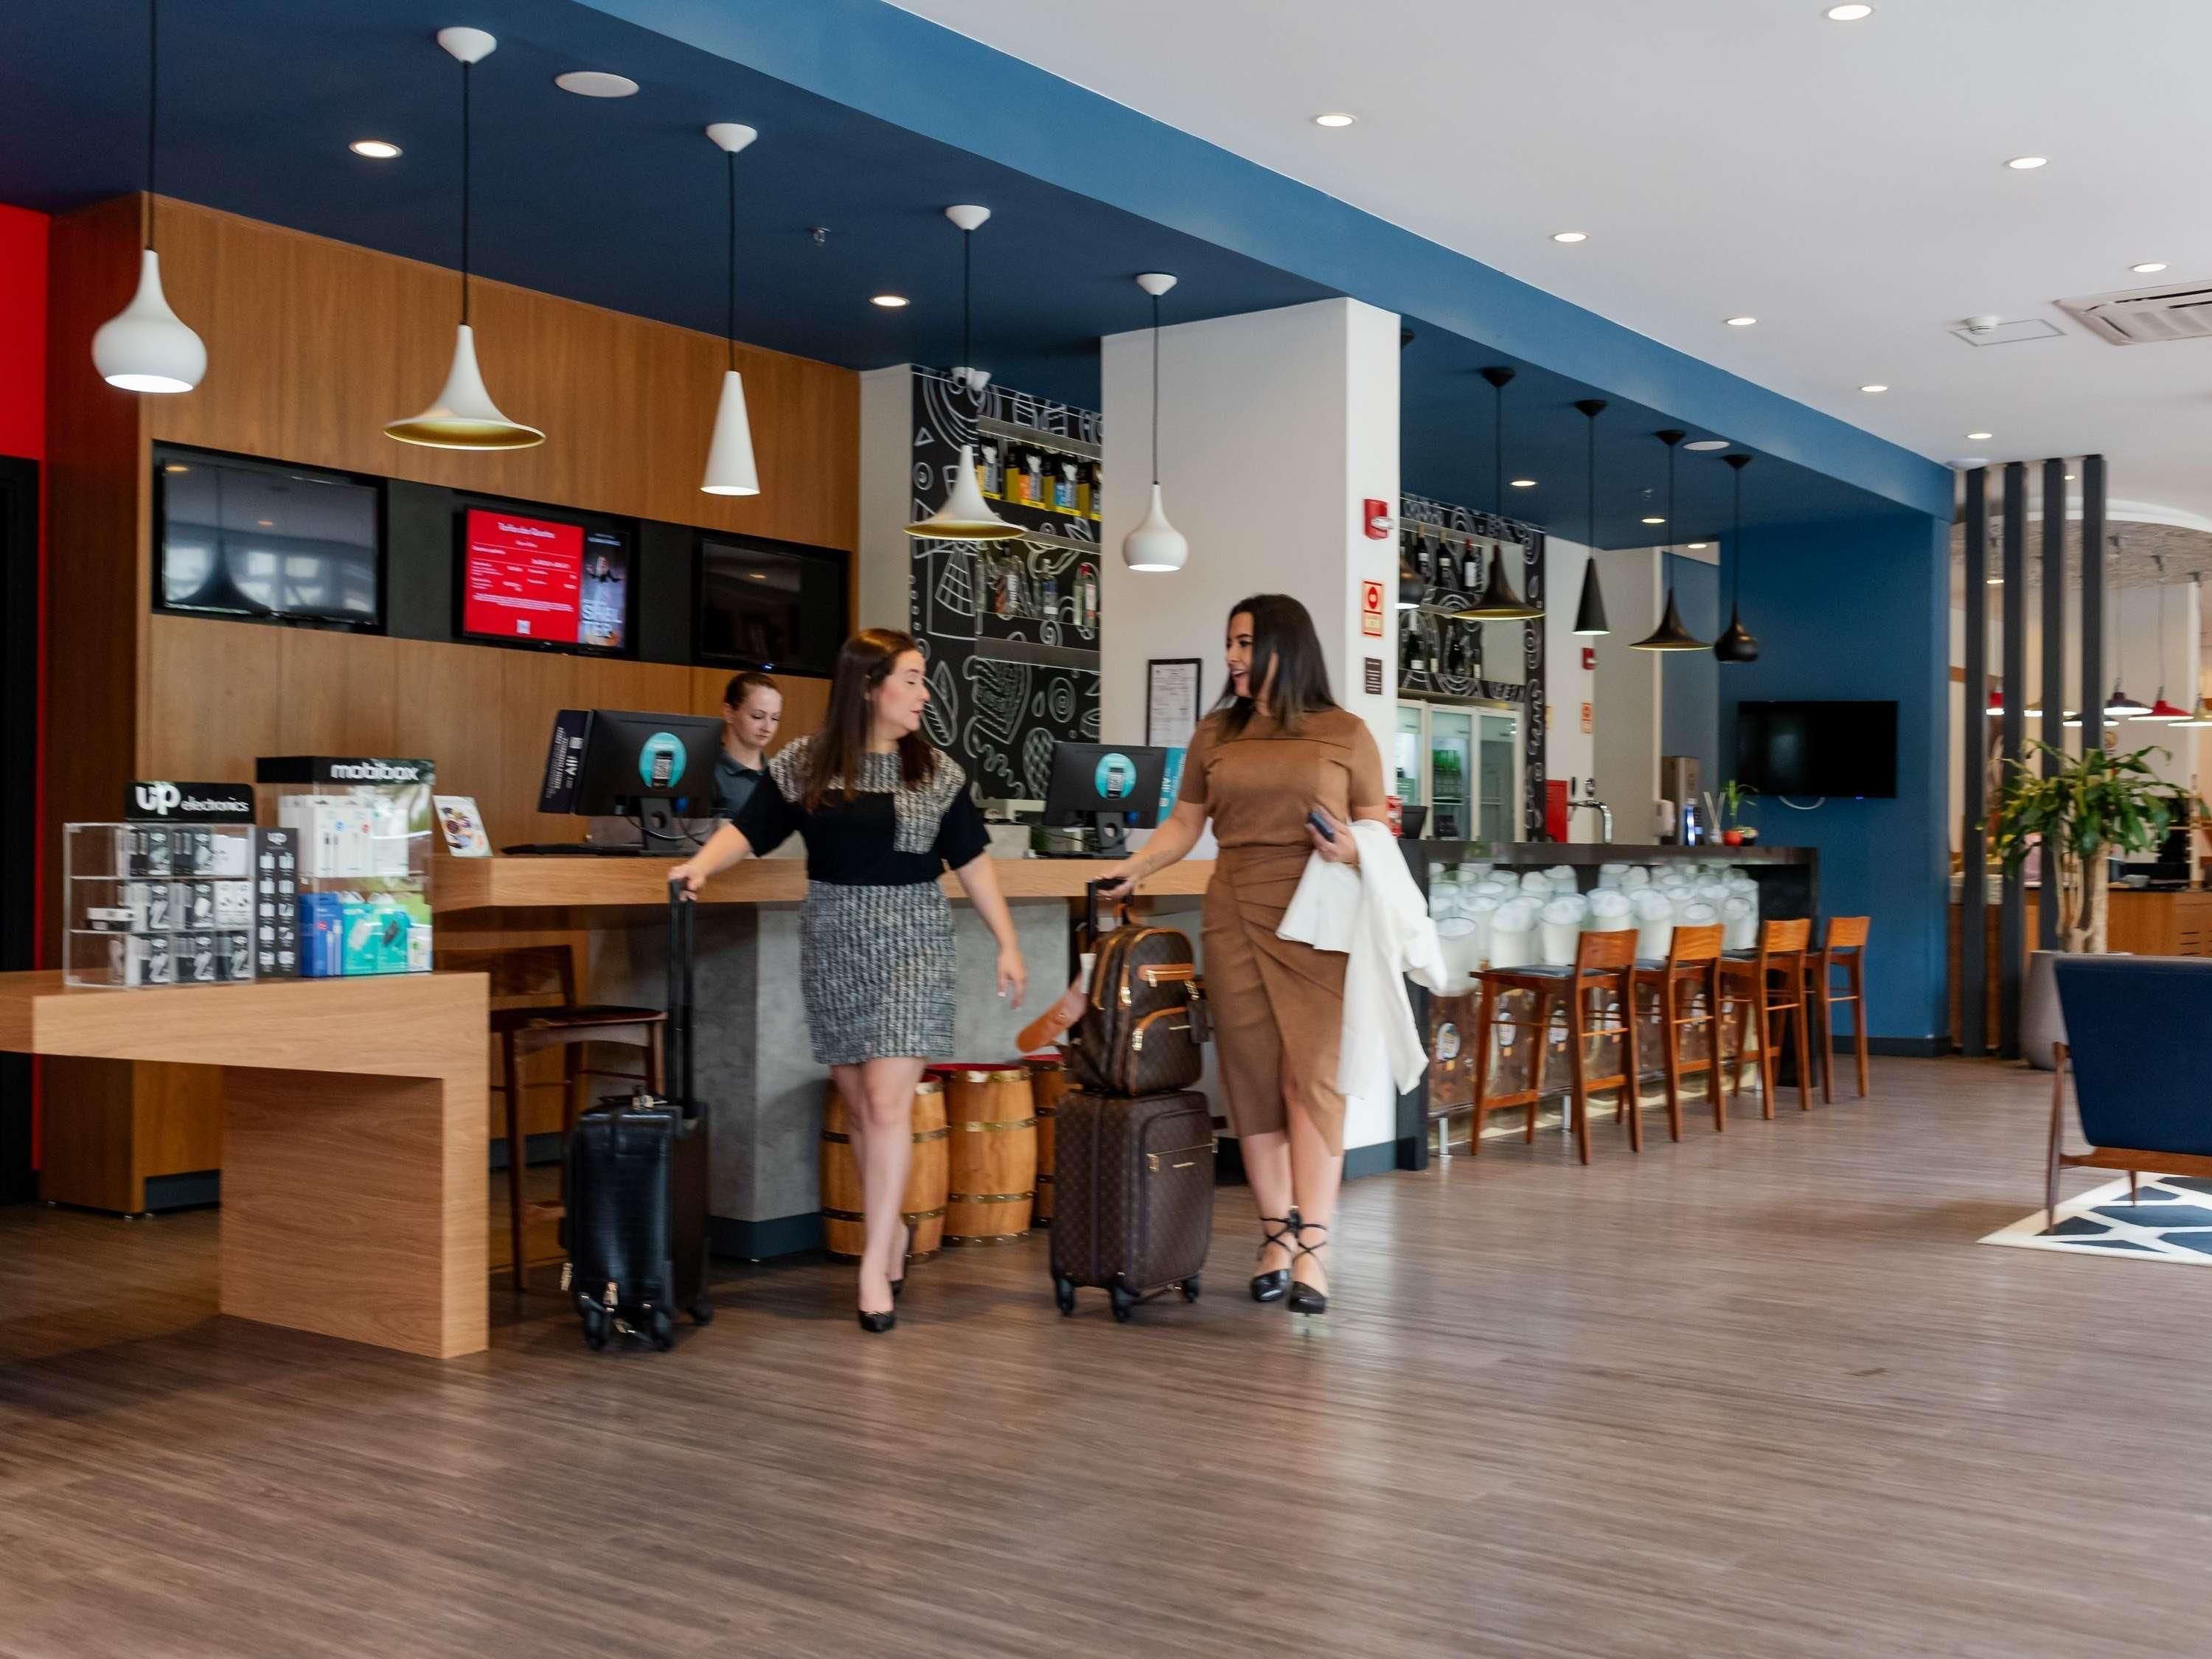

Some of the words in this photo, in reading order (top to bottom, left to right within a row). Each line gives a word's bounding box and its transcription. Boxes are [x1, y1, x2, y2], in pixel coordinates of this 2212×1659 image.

[331, 760, 419, 781] mobibox
[136, 782, 181, 815] up
[181, 796, 249, 812] electronics
